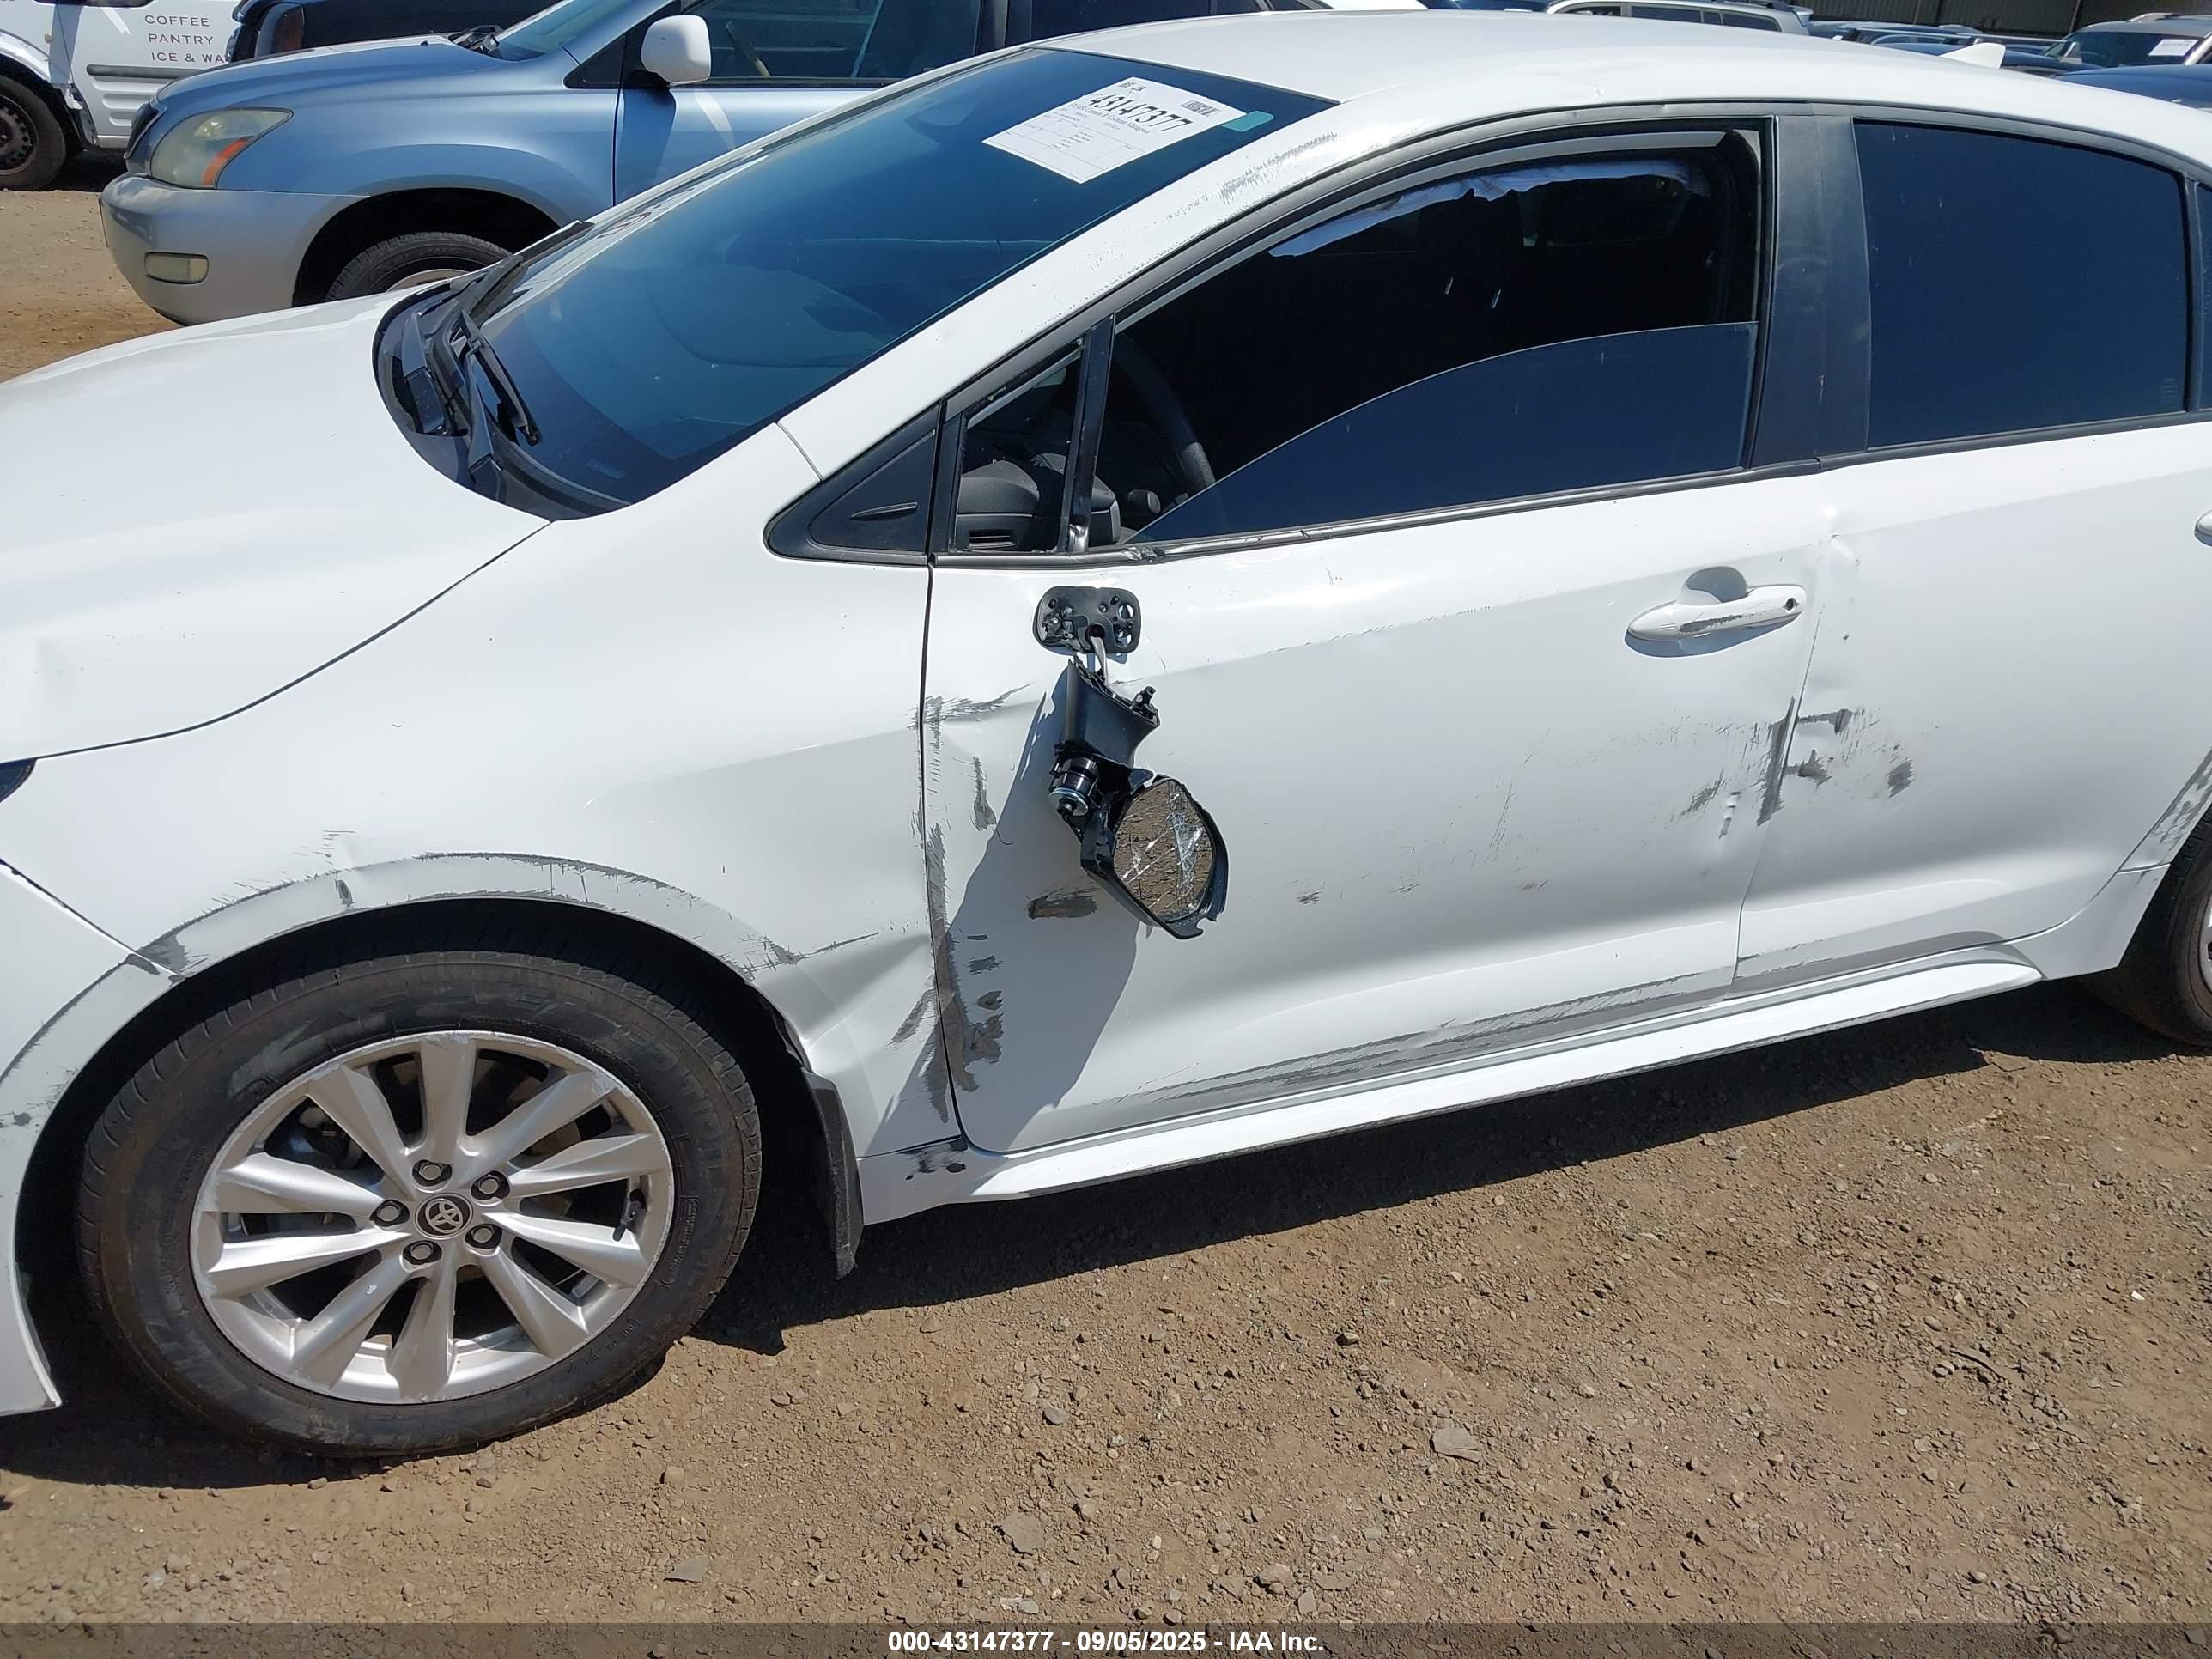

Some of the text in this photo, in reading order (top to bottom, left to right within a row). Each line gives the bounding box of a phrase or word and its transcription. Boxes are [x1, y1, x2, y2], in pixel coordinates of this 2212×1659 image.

[144, 15, 210, 27] COFFEE
[148, 33, 213, 45] PANTRY
[151, 52, 226, 63] ICE & WA
[1089, 94, 1194, 132] 43147377
